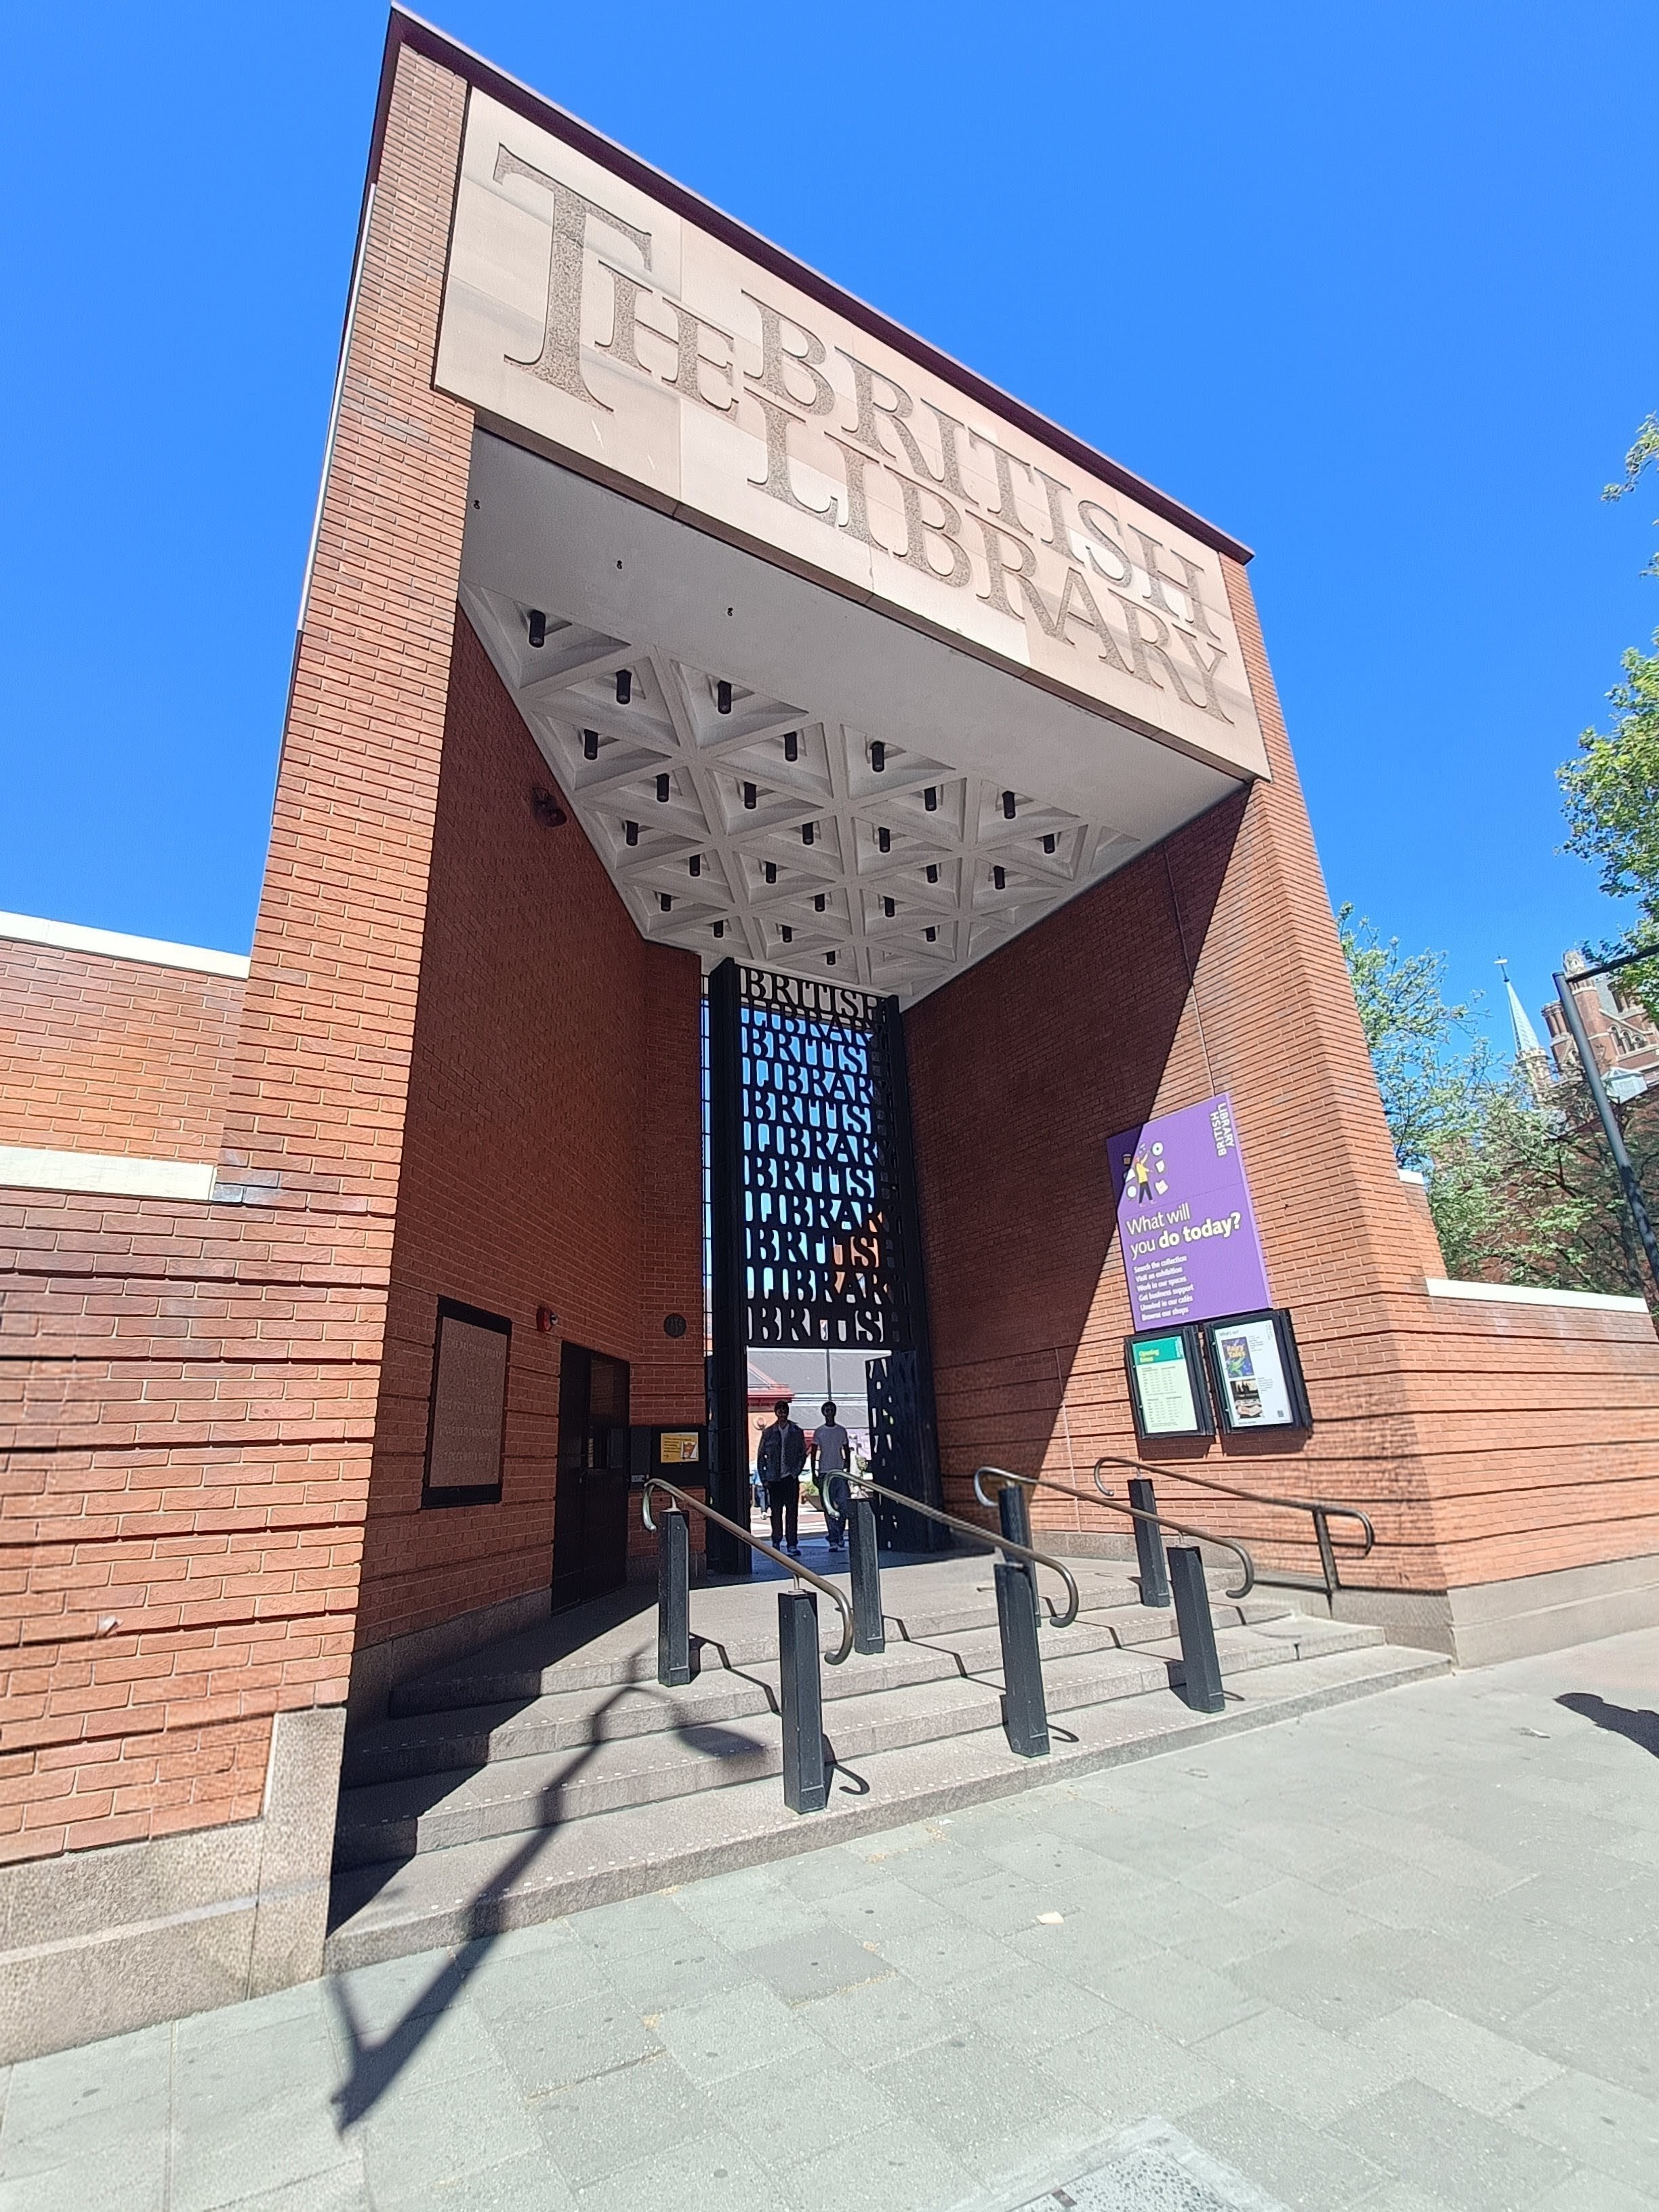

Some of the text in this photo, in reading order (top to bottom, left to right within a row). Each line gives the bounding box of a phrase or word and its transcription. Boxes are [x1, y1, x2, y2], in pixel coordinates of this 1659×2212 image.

[741, 289, 1221, 644] BRITISH
[743, 388, 1235, 726] LIBRARY
[1210, 1111, 1227, 1157] BRITISH
[1218, 1102, 1235, 1147] LIBRARY
[1126, 1202, 1191, 1235] What will
[1130, 1212, 1242, 1261] you do today?
[1134, 1263, 1151, 1273] Search
[1161, 1255, 1187, 1267] collection
[1135, 1274, 1148, 1282] Visit
[1156, 1267, 1183, 1278] exhibition
[1136, 1283, 1151, 1292] Work
[1168, 1275, 1187, 1286] spaces
[1139, 1284, 1194, 1301] Get business support
[1141, 1312, 1162, 1322] Browse
[1172, 1307, 1189, 1316] shops
